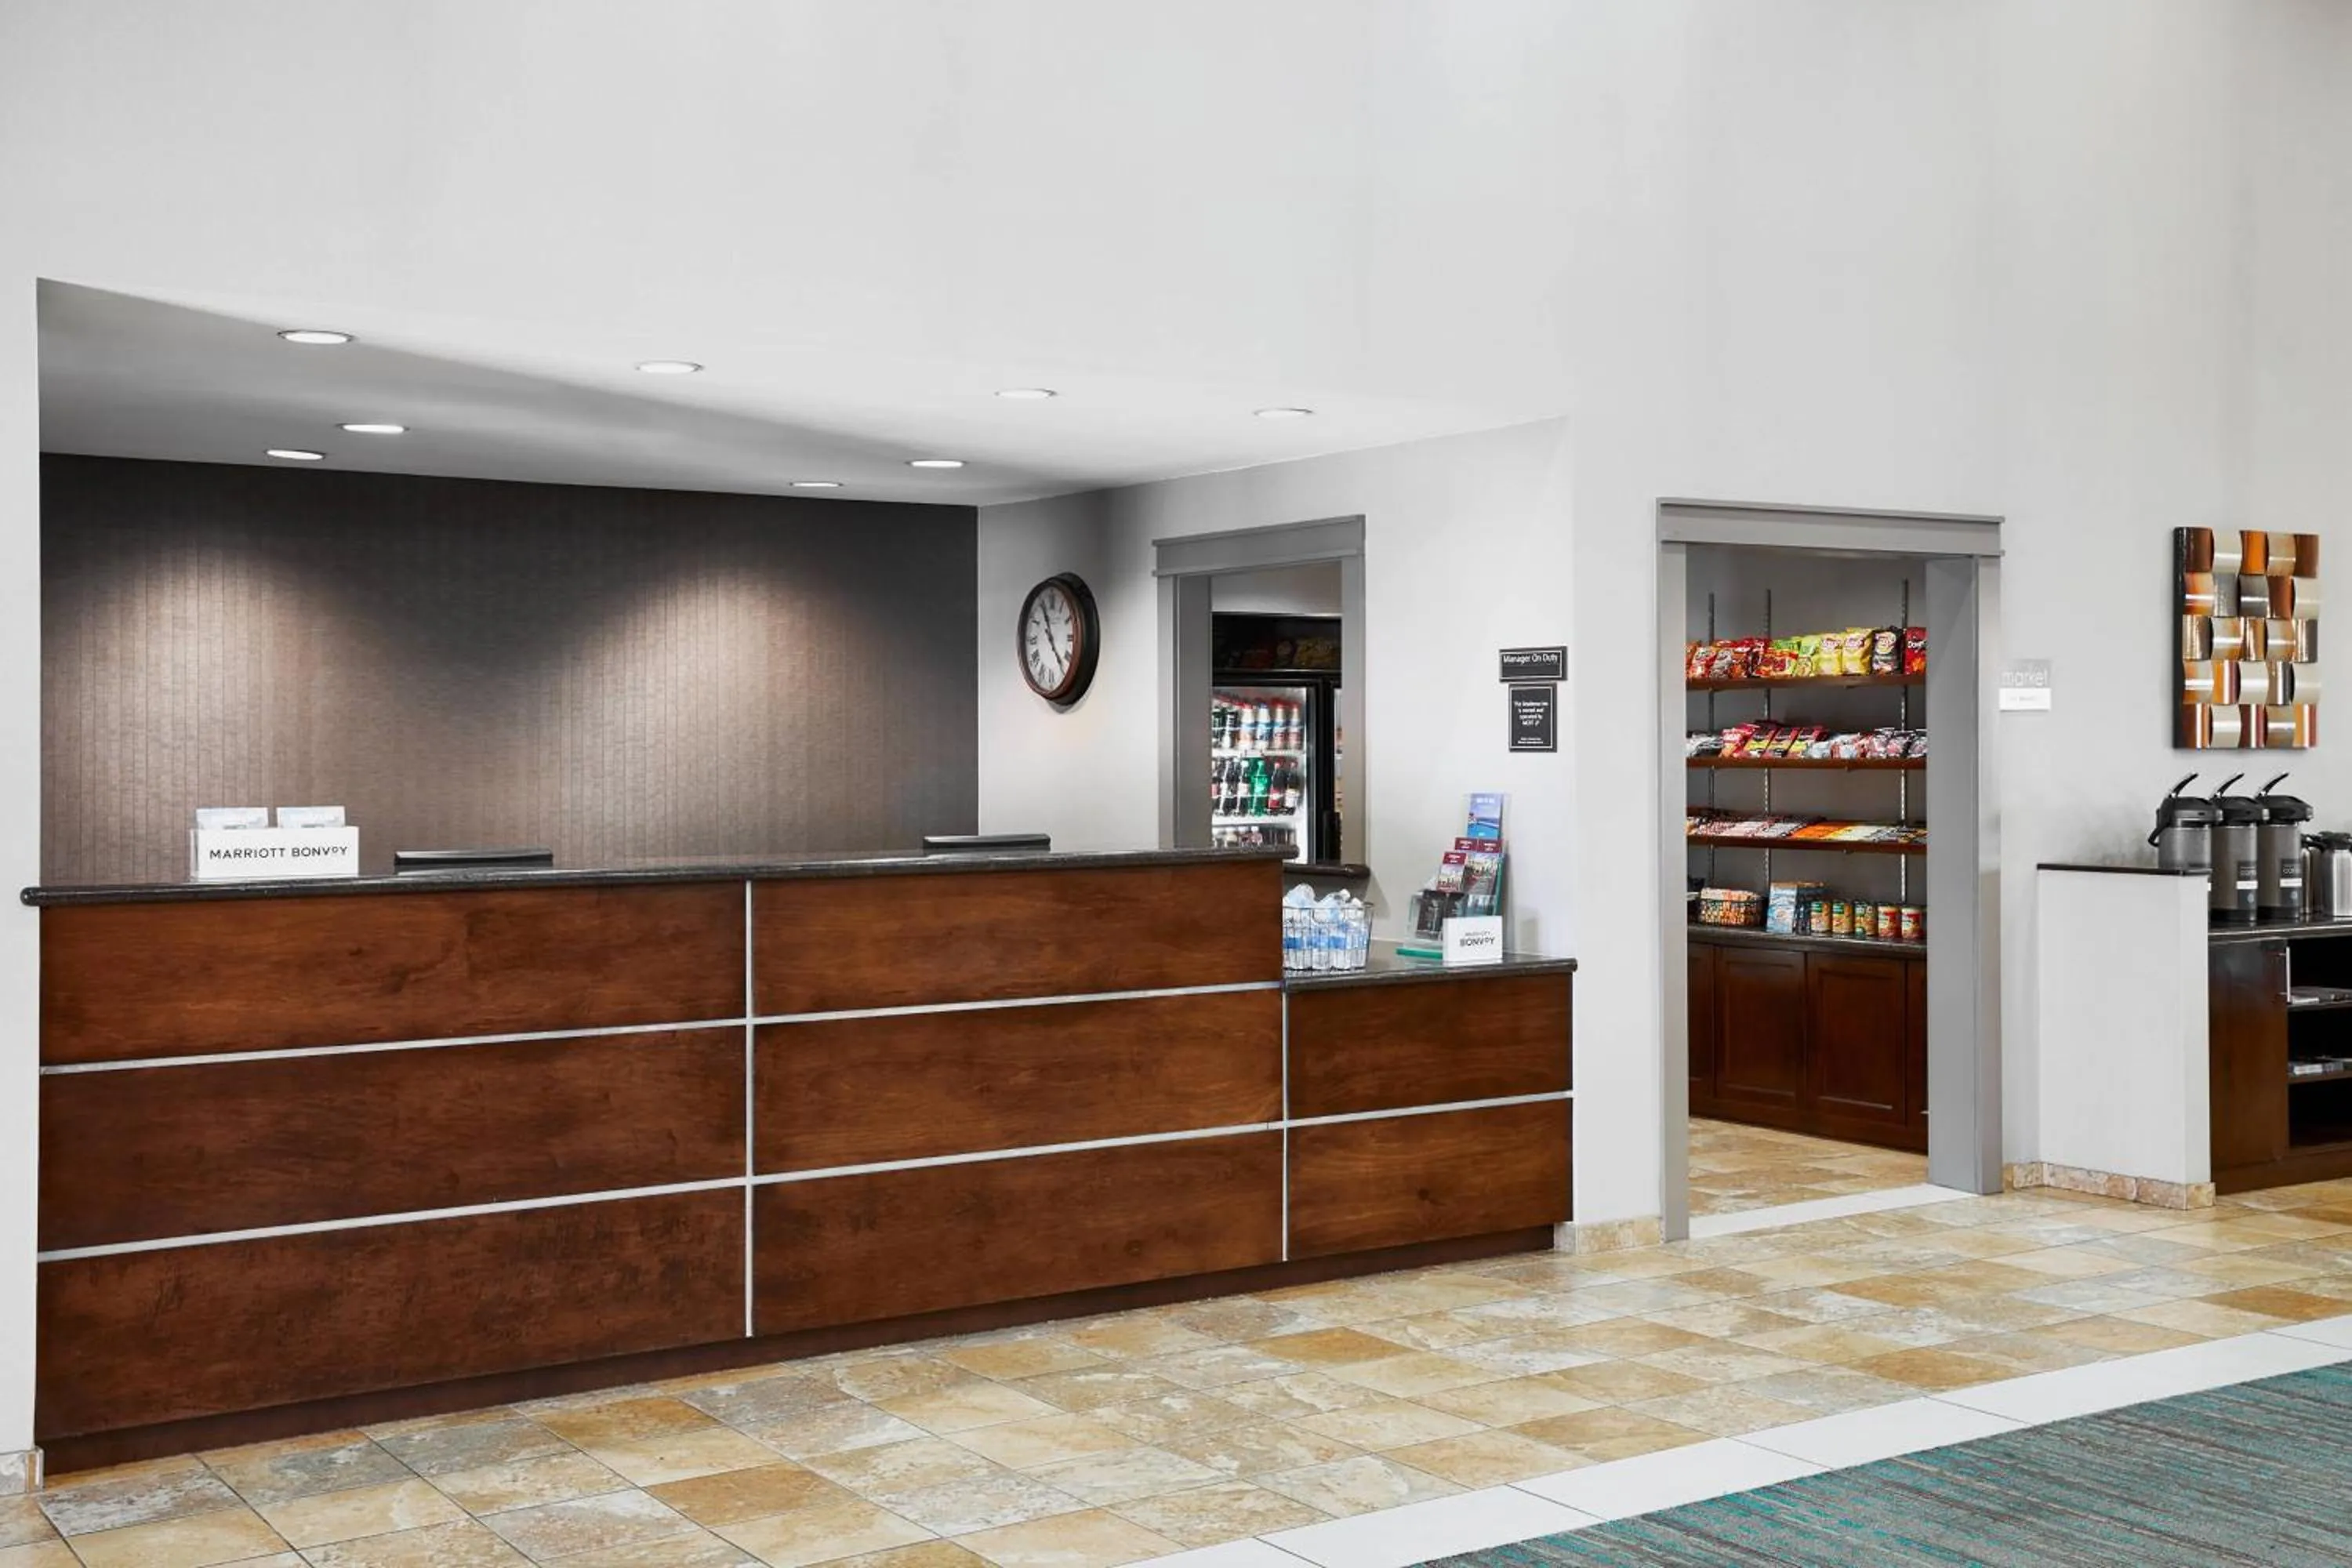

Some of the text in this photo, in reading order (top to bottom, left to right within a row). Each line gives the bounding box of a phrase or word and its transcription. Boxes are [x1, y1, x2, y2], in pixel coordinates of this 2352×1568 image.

[1503, 653, 1558, 665] Manager On Duty
[209, 848, 286, 860] MARRIOTT
